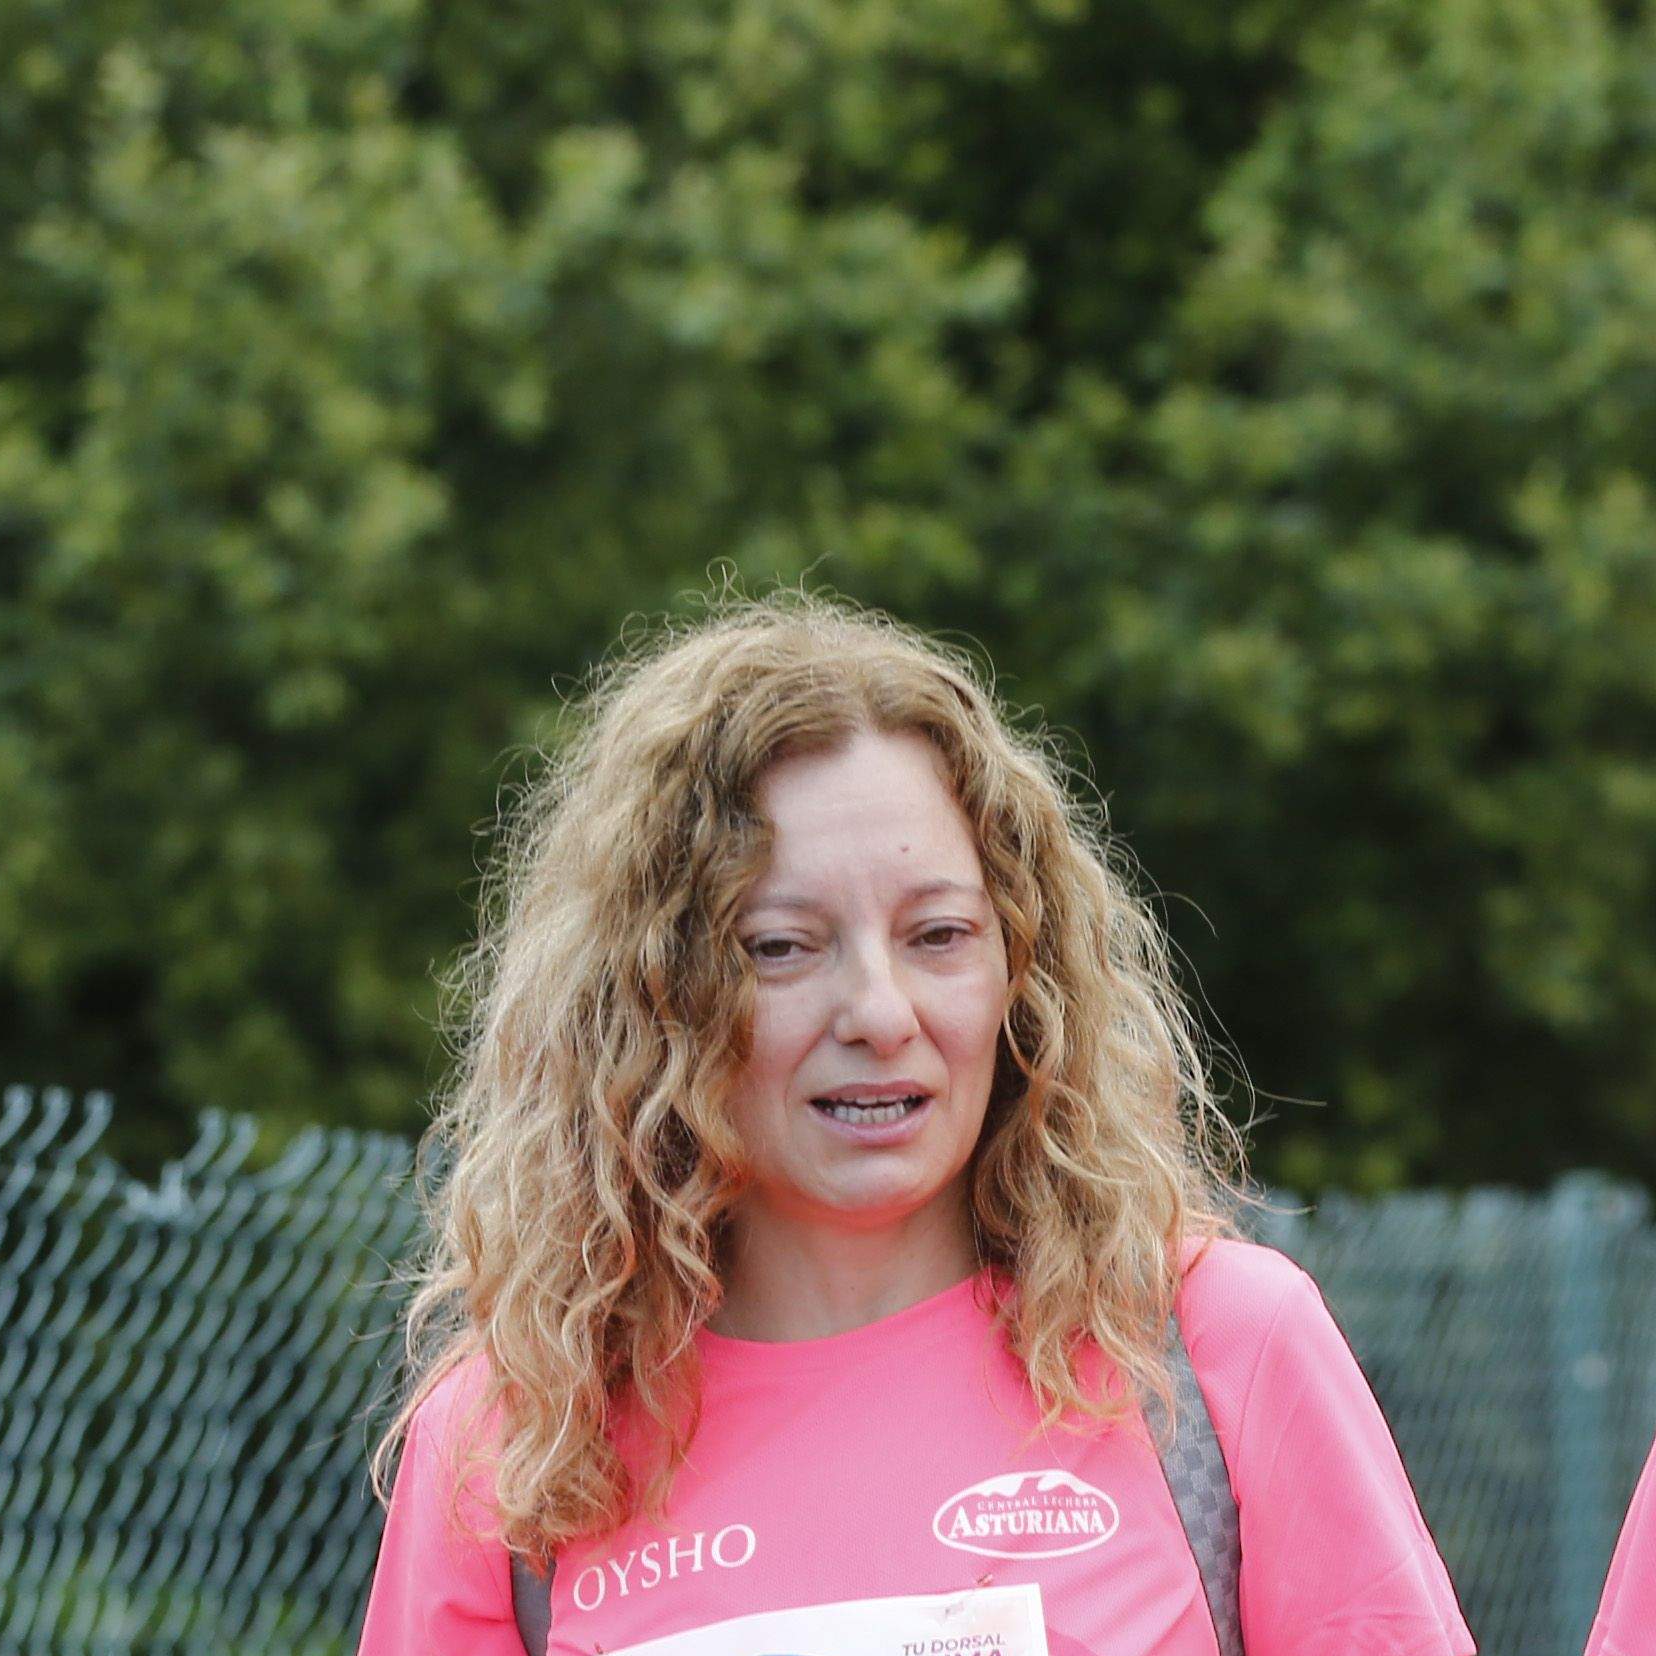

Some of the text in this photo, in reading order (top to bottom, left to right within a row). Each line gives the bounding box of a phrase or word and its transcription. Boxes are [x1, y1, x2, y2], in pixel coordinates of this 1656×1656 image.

[977, 1496, 1037, 1512] CENTRAL
[948, 1505, 1106, 1539] ASTURIANA
[572, 1523, 757, 1612] OYSHO
[903, 1633, 1007, 1656] TU DORSAL
